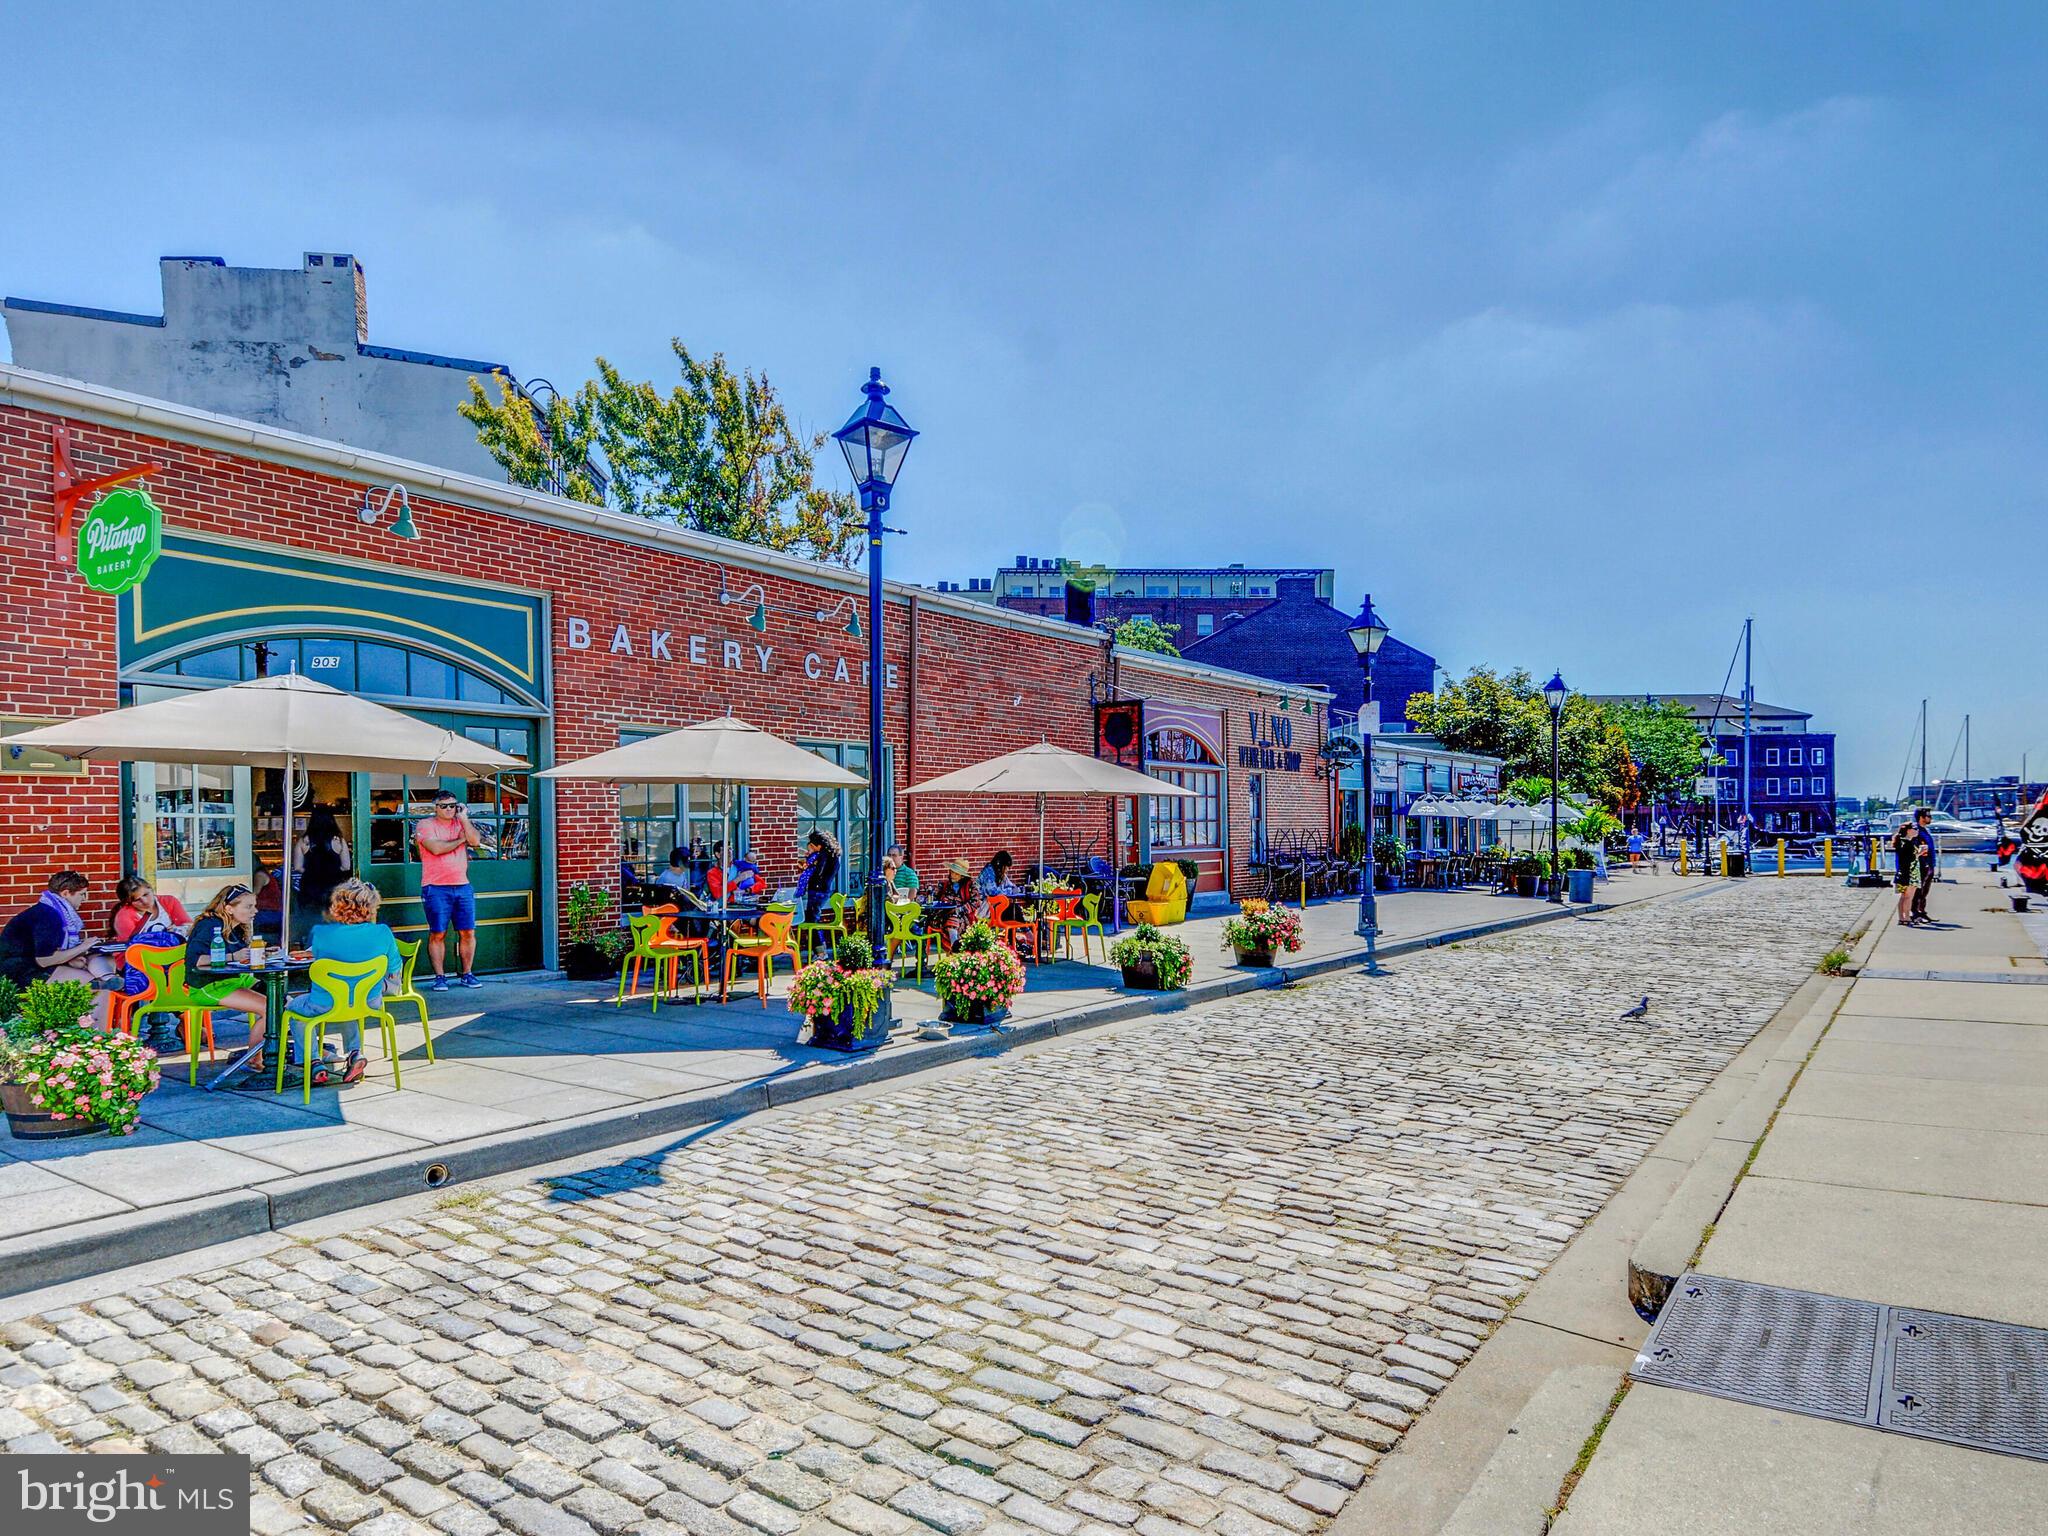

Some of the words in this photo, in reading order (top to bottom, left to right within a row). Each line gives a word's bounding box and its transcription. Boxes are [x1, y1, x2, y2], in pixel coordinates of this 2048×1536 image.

[87, 516, 146, 559] Pitango
[97, 559, 131, 575] BAKERY
[313, 657, 338, 667] 903
[568, 617, 773, 673] BAKERY
[804, 652, 898, 688] CAFE
[1248, 707, 1292, 748] VINO
[1239, 745, 1259, 768] WINE
[1260, 748, 1275, 769] BAR
[1284, 751, 1302, 772] SHOP
